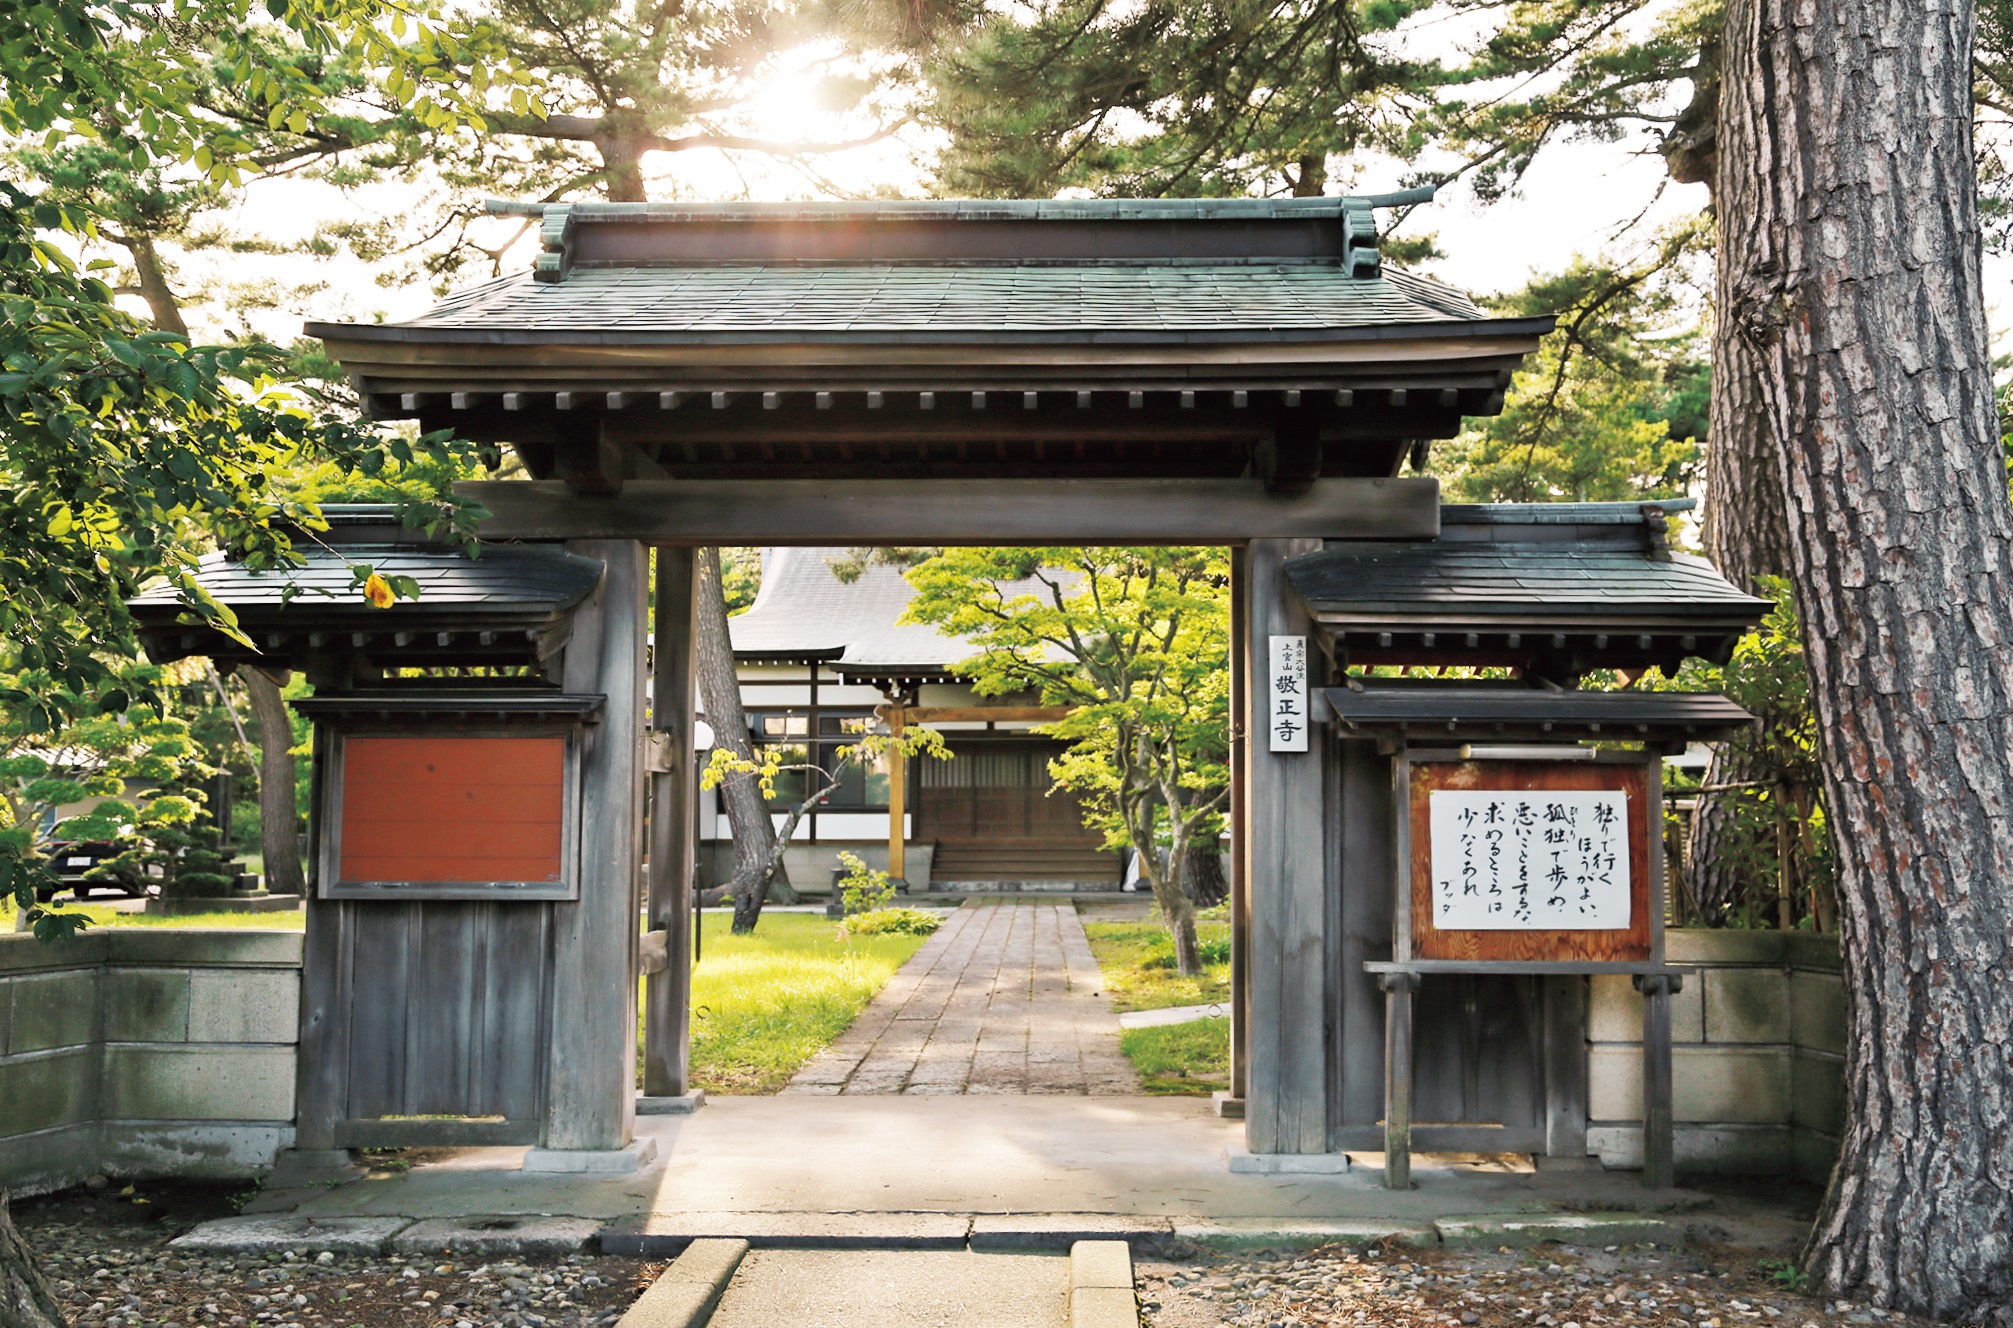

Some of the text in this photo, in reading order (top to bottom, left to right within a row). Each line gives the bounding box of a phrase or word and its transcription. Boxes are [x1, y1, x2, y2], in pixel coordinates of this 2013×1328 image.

[1458, 807, 1480, 897] 少なくあれ
[1484, 801, 1505, 913] 求めるところは
[1592, 802, 1619, 885] 独りで行く
[1440, 879, 1456, 917] ブッダ
